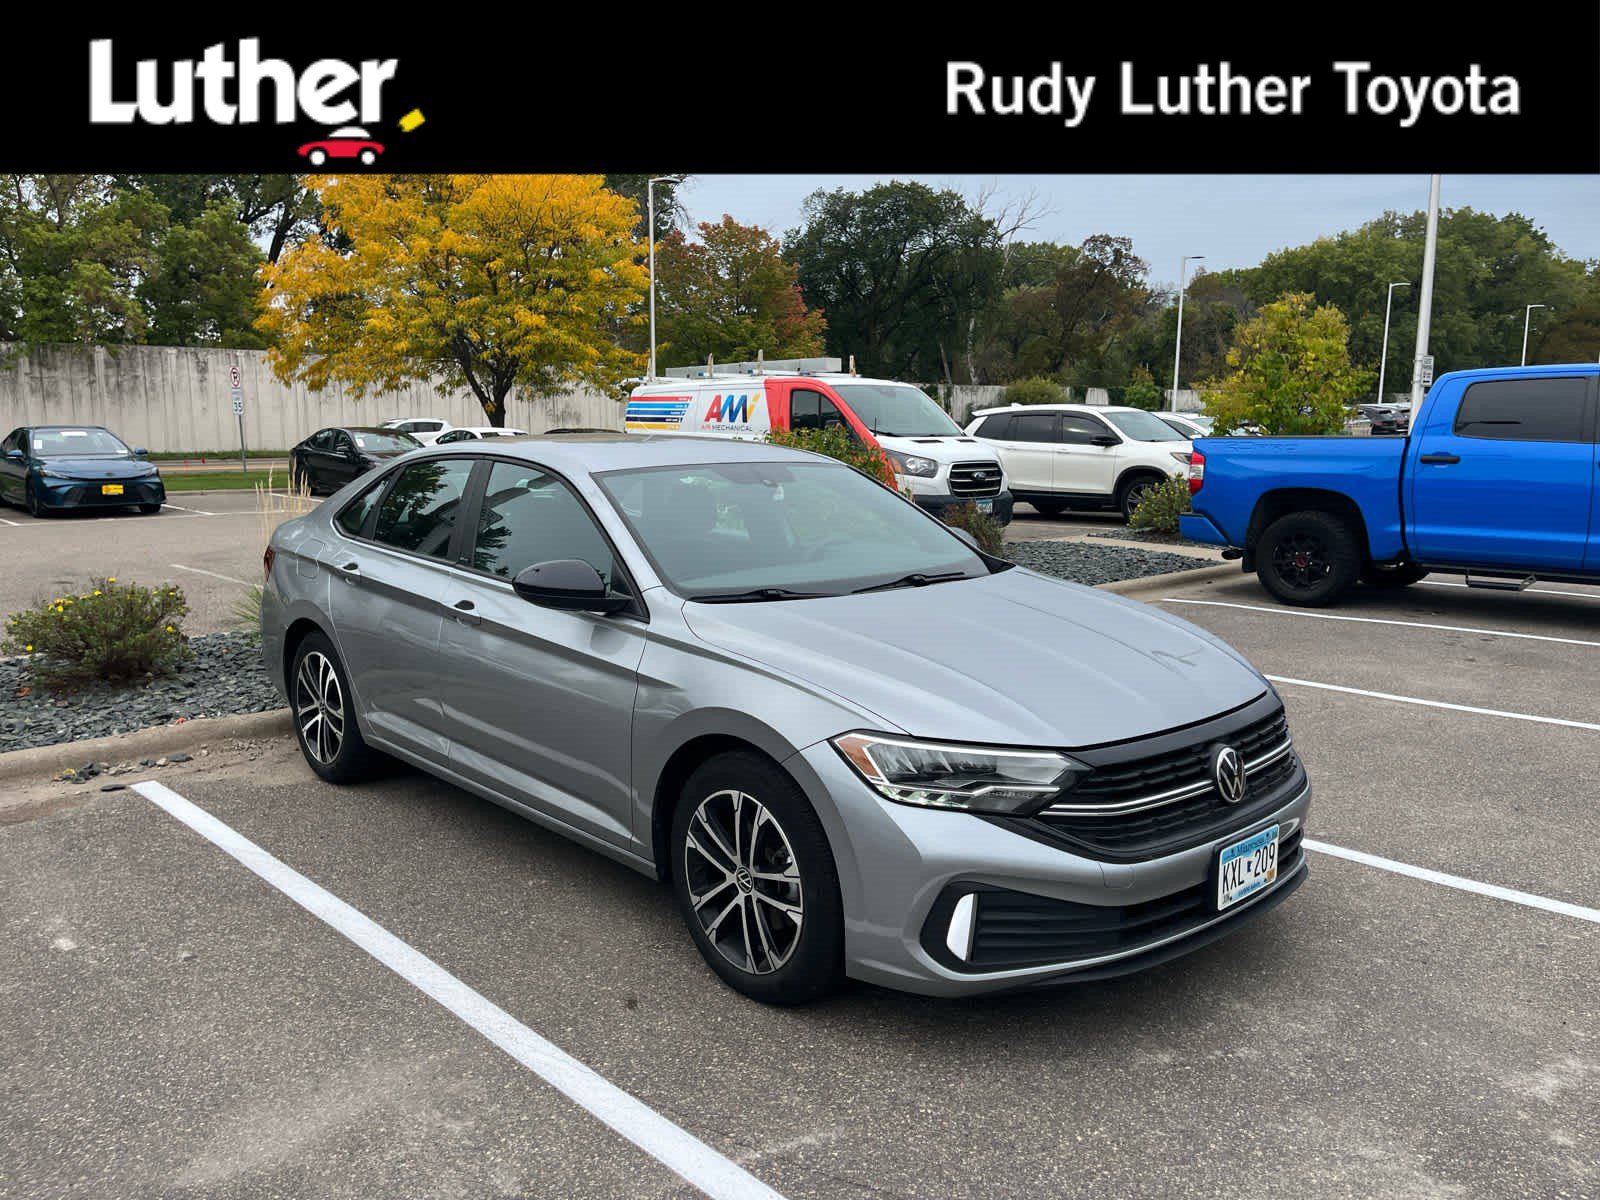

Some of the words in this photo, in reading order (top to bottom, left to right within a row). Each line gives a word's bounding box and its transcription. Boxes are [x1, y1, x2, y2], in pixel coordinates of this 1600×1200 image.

[712, 424, 753, 432] MECHANICAL
[1222, 856, 1245, 895] KXL
[1254, 841, 1276, 878] 209
